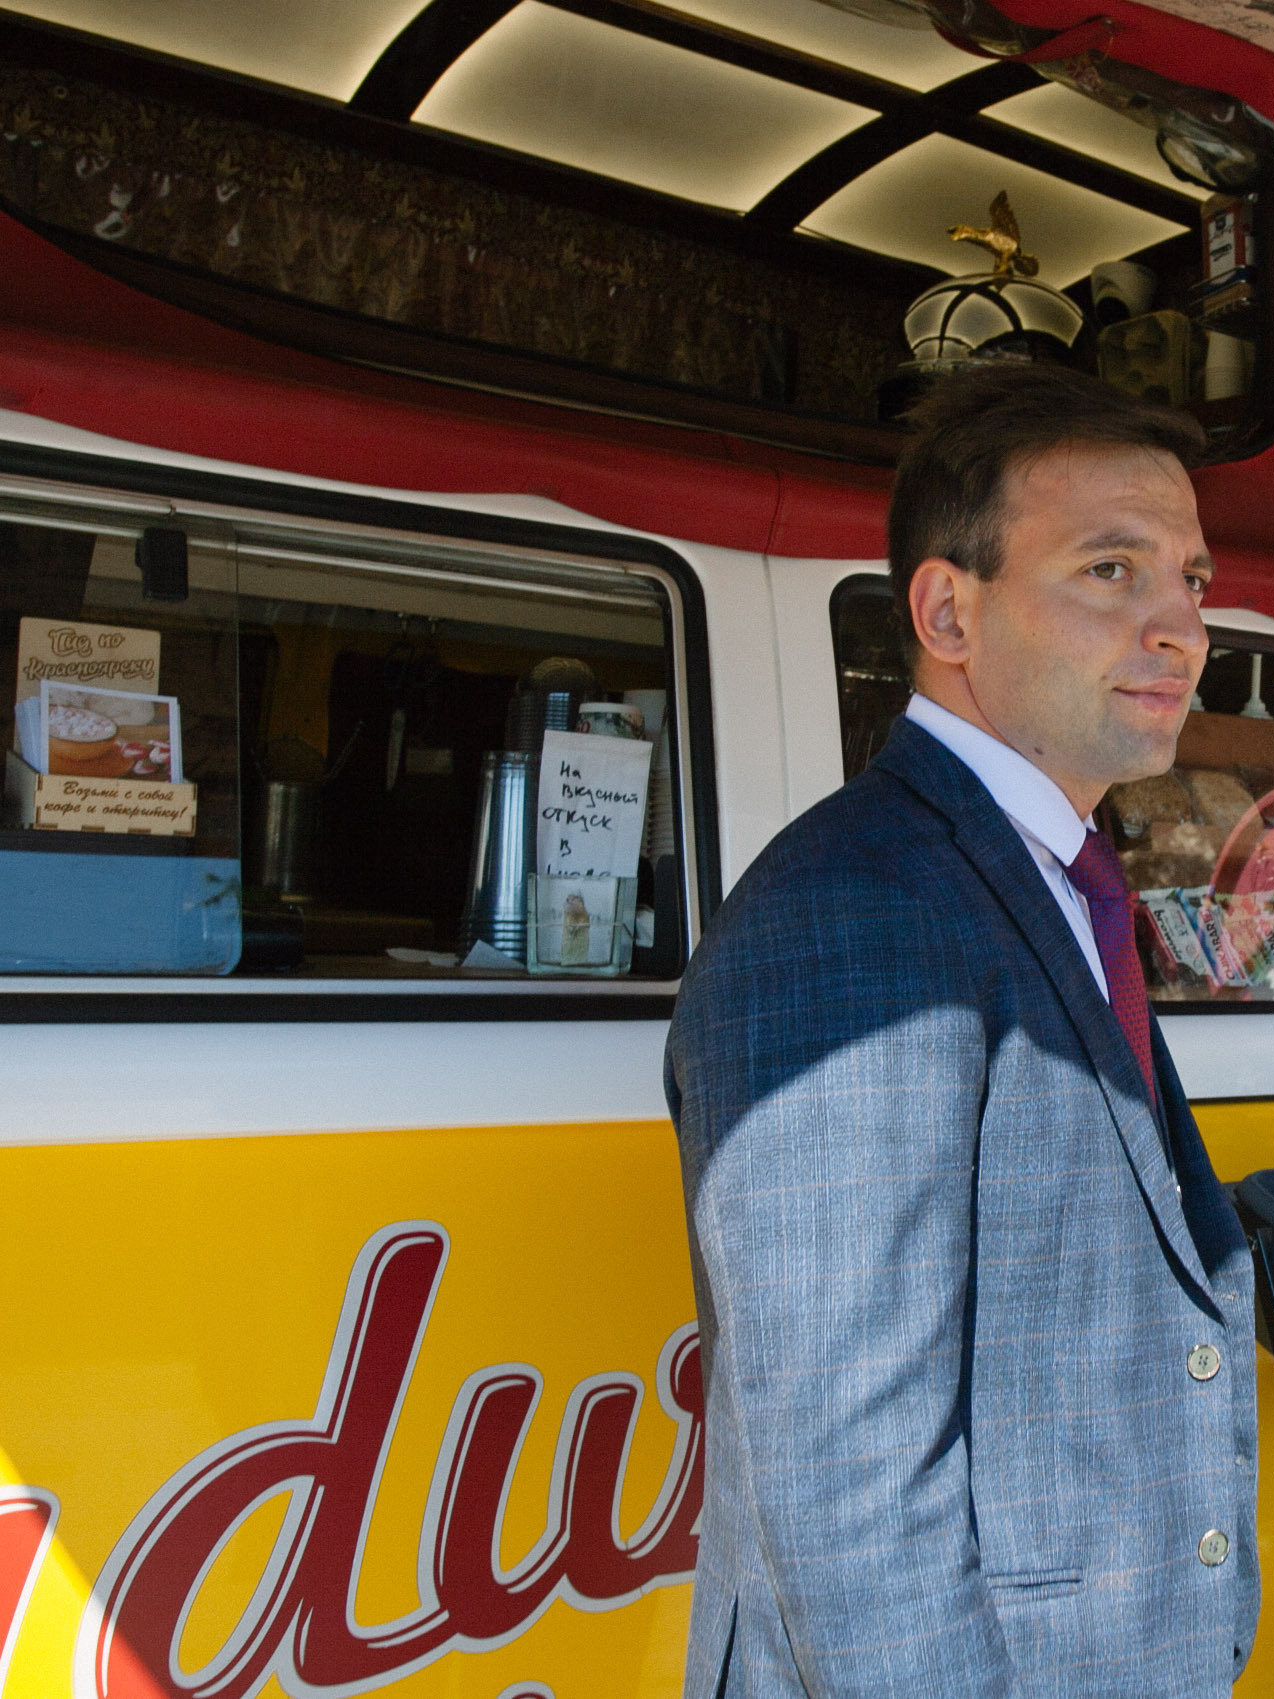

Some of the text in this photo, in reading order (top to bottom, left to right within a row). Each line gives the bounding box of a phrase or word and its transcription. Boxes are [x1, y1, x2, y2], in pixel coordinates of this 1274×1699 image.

[48, 627, 126, 657] Гид по
[23, 656, 155, 681] Красноярску
[560, 761, 581, 779] На
[63, 781, 175, 802] Возьми с собой
[44, 801, 189, 821] кофе и открытку!
